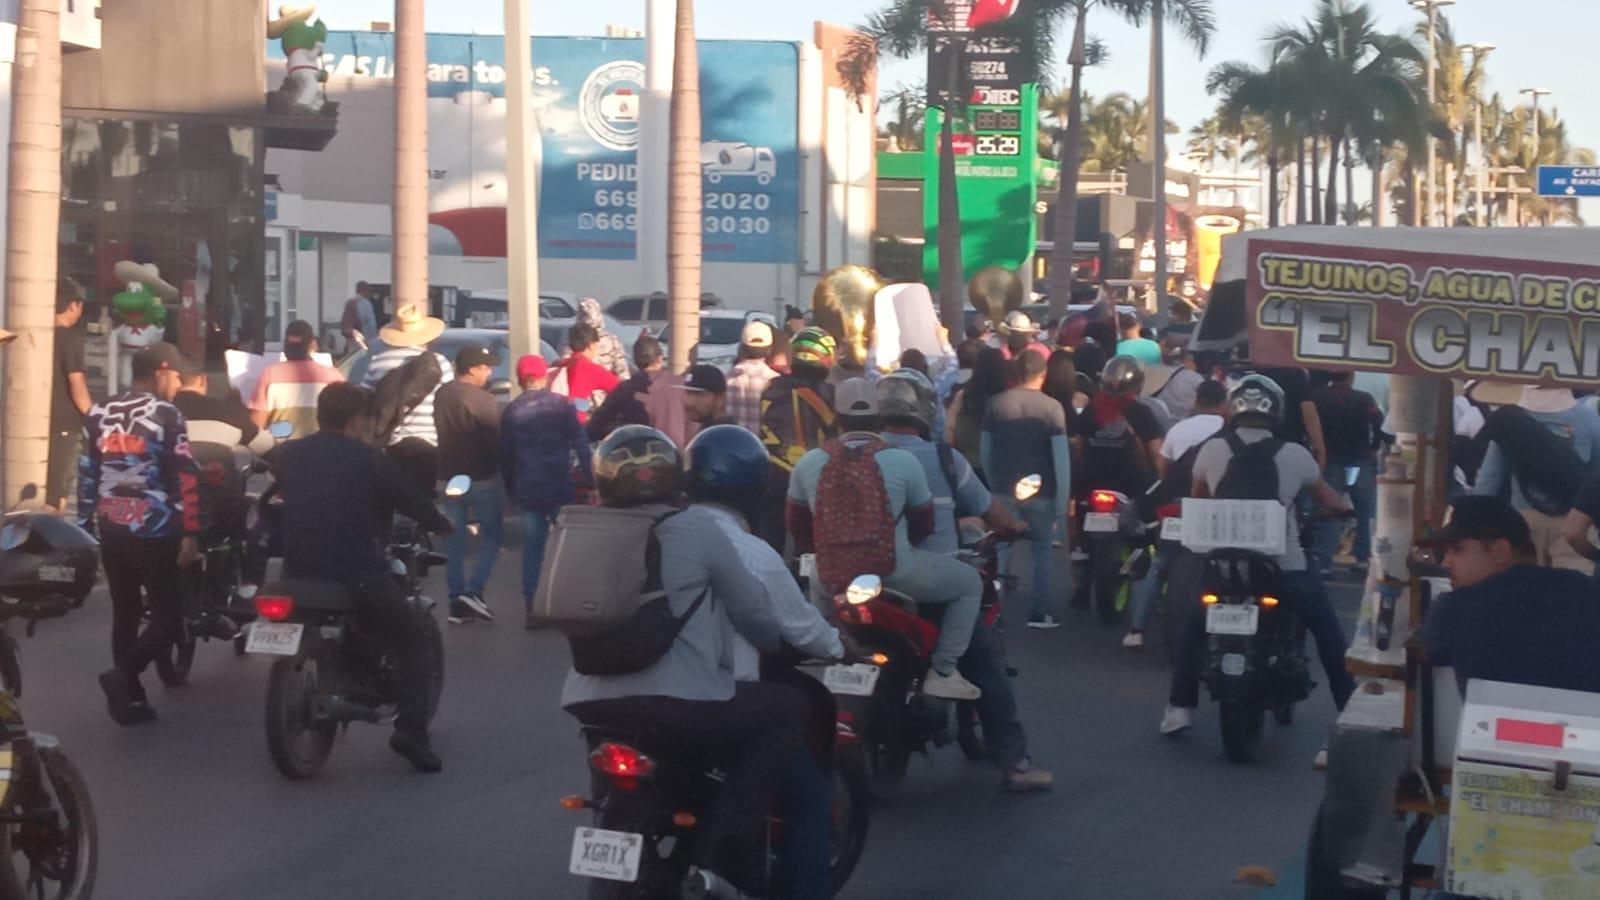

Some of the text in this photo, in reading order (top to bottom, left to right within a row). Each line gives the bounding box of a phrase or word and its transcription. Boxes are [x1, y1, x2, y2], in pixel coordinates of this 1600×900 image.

[427, 62, 468, 82] ara
[474, 61, 559, 85] tos.
[577, 163, 637, 181] PEDID
[705, 192, 770, 210] 2020
[705, 216, 770, 234] 3030
[1263, 257, 1600, 310] TEJUINOS, AGUA DE C
